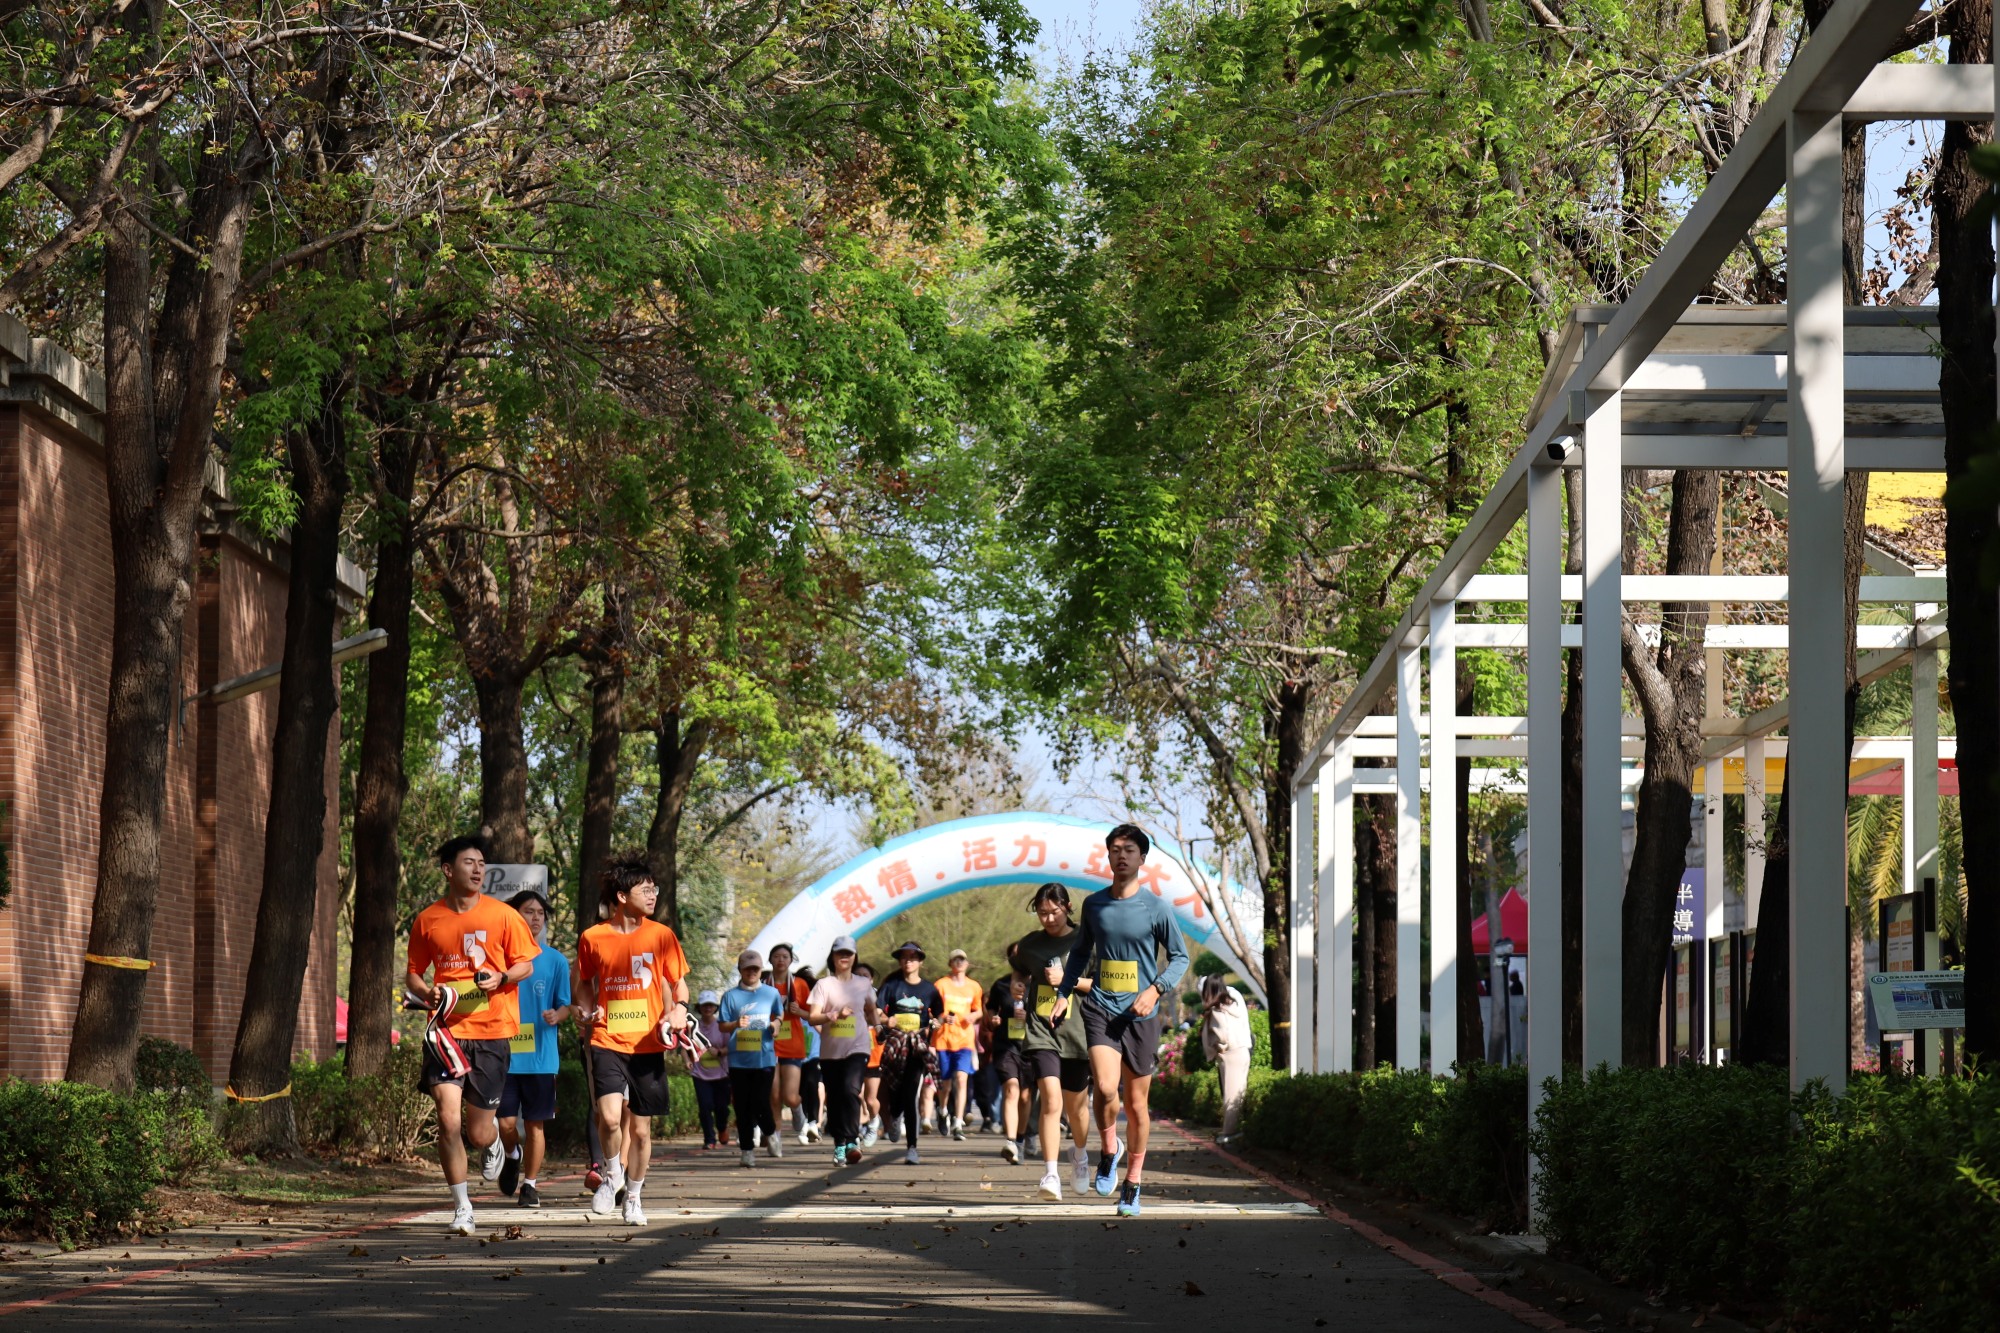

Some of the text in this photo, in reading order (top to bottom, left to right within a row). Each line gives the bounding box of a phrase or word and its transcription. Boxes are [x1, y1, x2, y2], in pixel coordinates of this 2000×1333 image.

[482, 868, 543, 895] Practice Hotel
[613, 976, 629, 984] ASIA
[1101, 970, 1136, 980] 05K021A
[608, 1011, 647, 1021] 05K002A
